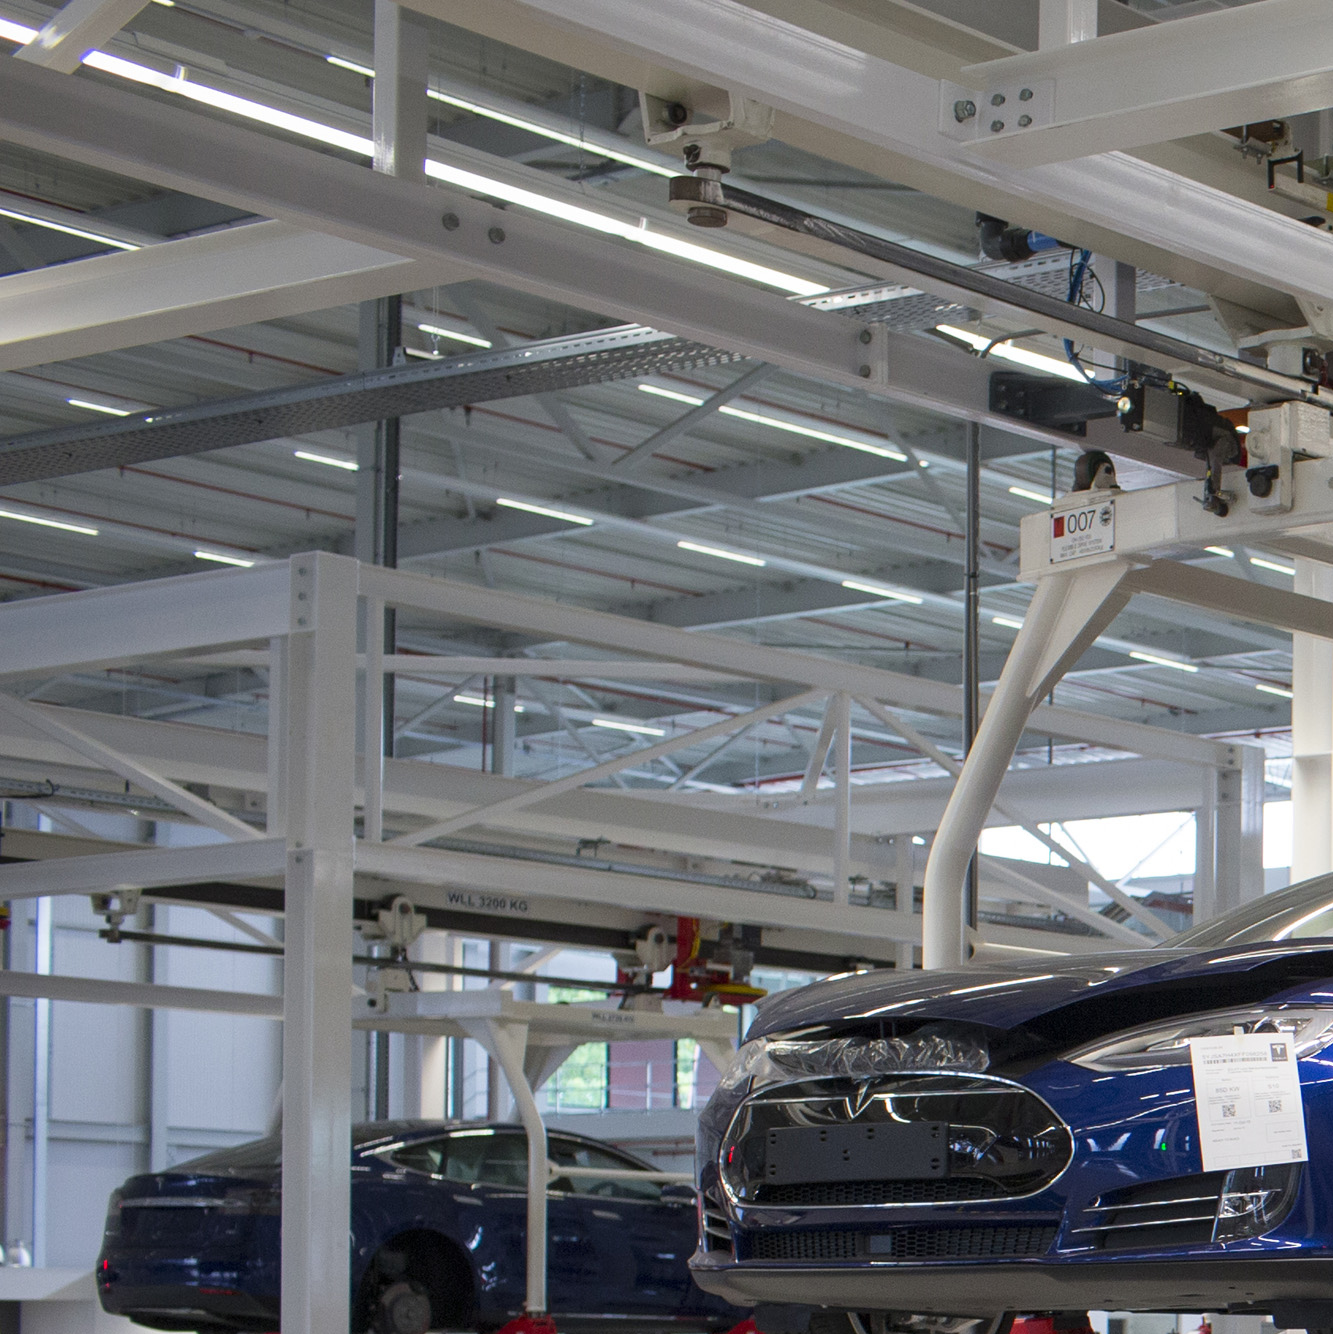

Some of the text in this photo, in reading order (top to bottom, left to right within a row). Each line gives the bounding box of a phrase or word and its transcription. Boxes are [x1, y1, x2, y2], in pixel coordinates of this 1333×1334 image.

[1068, 509, 1096, 534] 007
[449, 893, 528, 912] WLL 3200 KG
